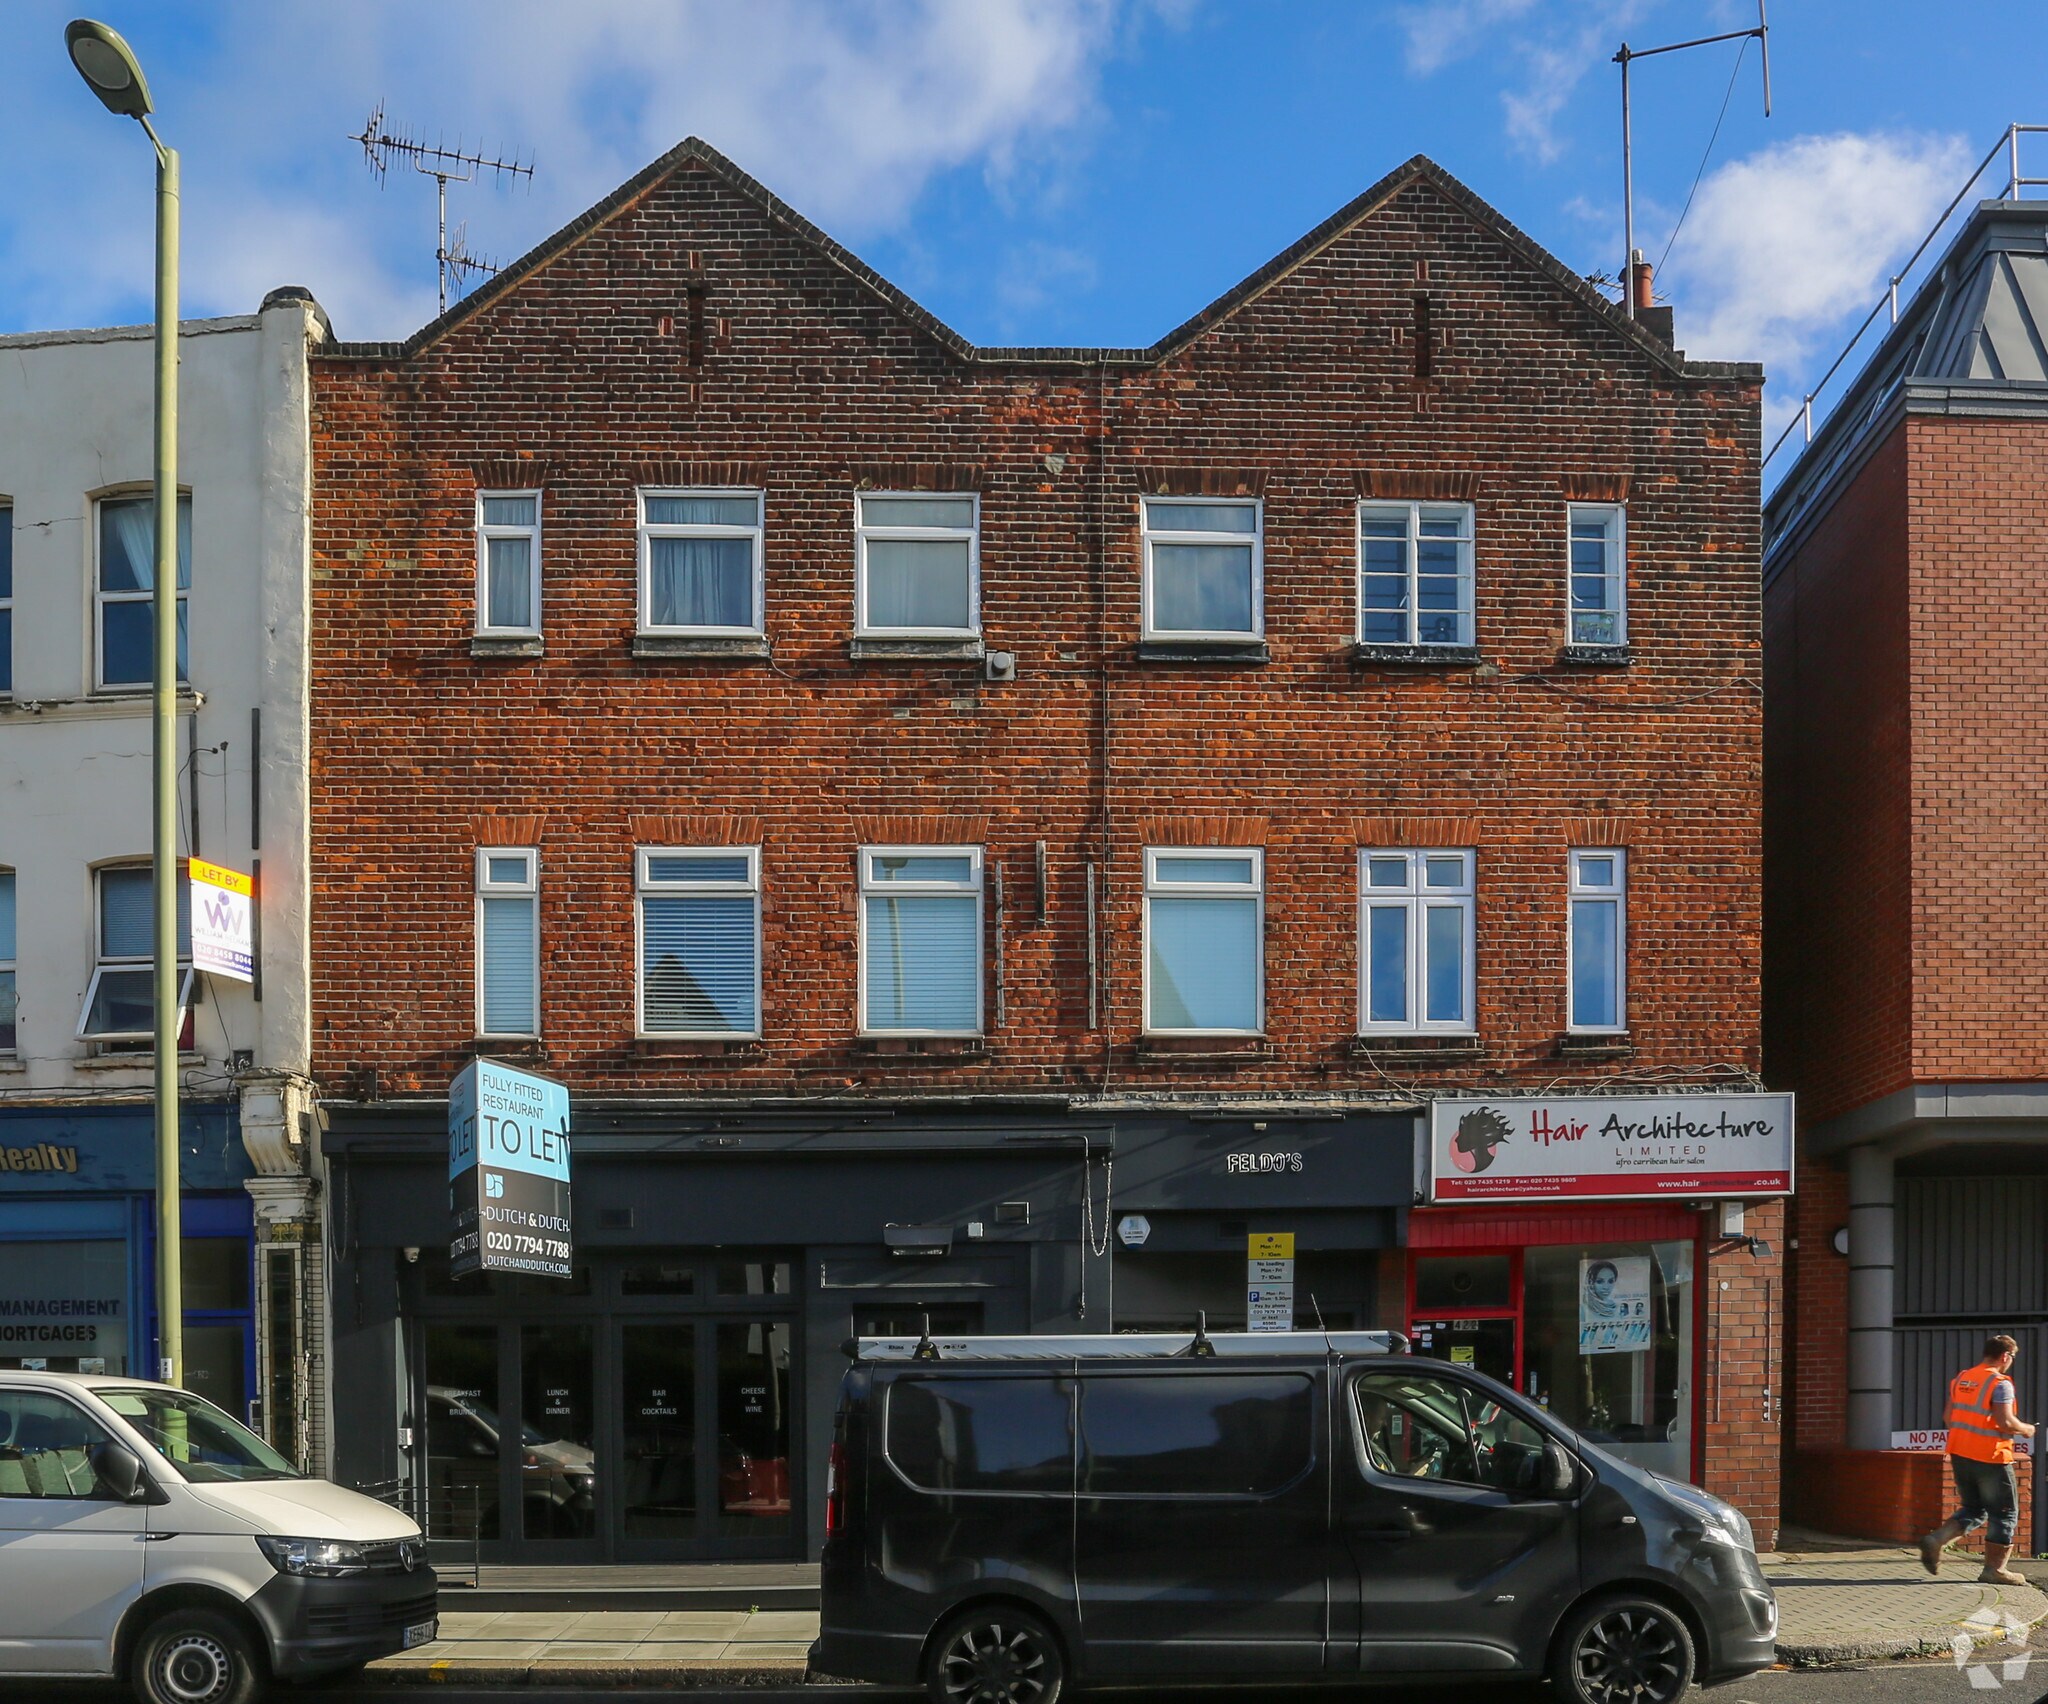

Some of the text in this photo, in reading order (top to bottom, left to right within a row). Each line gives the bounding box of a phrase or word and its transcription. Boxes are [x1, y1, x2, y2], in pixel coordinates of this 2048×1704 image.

[202, 867, 239, 888] LET BY
[483, 1074, 512, 1093] FULLY
[515, 1082, 543, 1102] FITTED
[483, 1093, 544, 1120] RESTAURANT
[1529, 1108, 1774, 1147] Hair Architecture
[458, 1115, 475, 1157] LET
[483, 1114, 565, 1165] TO LET
[1615, 1145, 1706, 1156] LIMITED
[1227, 1152, 1303, 1173] FELDO'S
[1615, 1157, 1632, 1168] afro
[1669, 1157, 1685, 1165] hair
[1686, 1157, 1705, 1165] salon
[486, 1205, 527, 1225] DUTCH
[528, 1212, 537, 1227] &
[538, 1214, 569, 1232] DUTCH
[487, 1231, 569, 1259] 020 7794 7788
[487, 1254, 569, 1274] DUTCHANDDUTCH.COM
[0, 1299, 120, 1317] MANAGEMENT
[0, 1324, 97, 1342] ORTGAGES
[444, 1389, 481, 1397] BREAKFAST
[652, 1389, 666, 1397] BAR
[741, 1387, 766, 1395] CHEESE
[555, 1398, 561, 1406] &
[656, 1398, 662, 1406] &
[745, 1405, 763, 1413] WINE
[449, 1408, 477, 1416] BRUNCH
[545, 1407, 571, 1415] DINNER
[641, 1407, 677, 1416] COCKTAILS
[1909, 1431, 1928, 1444] NO
